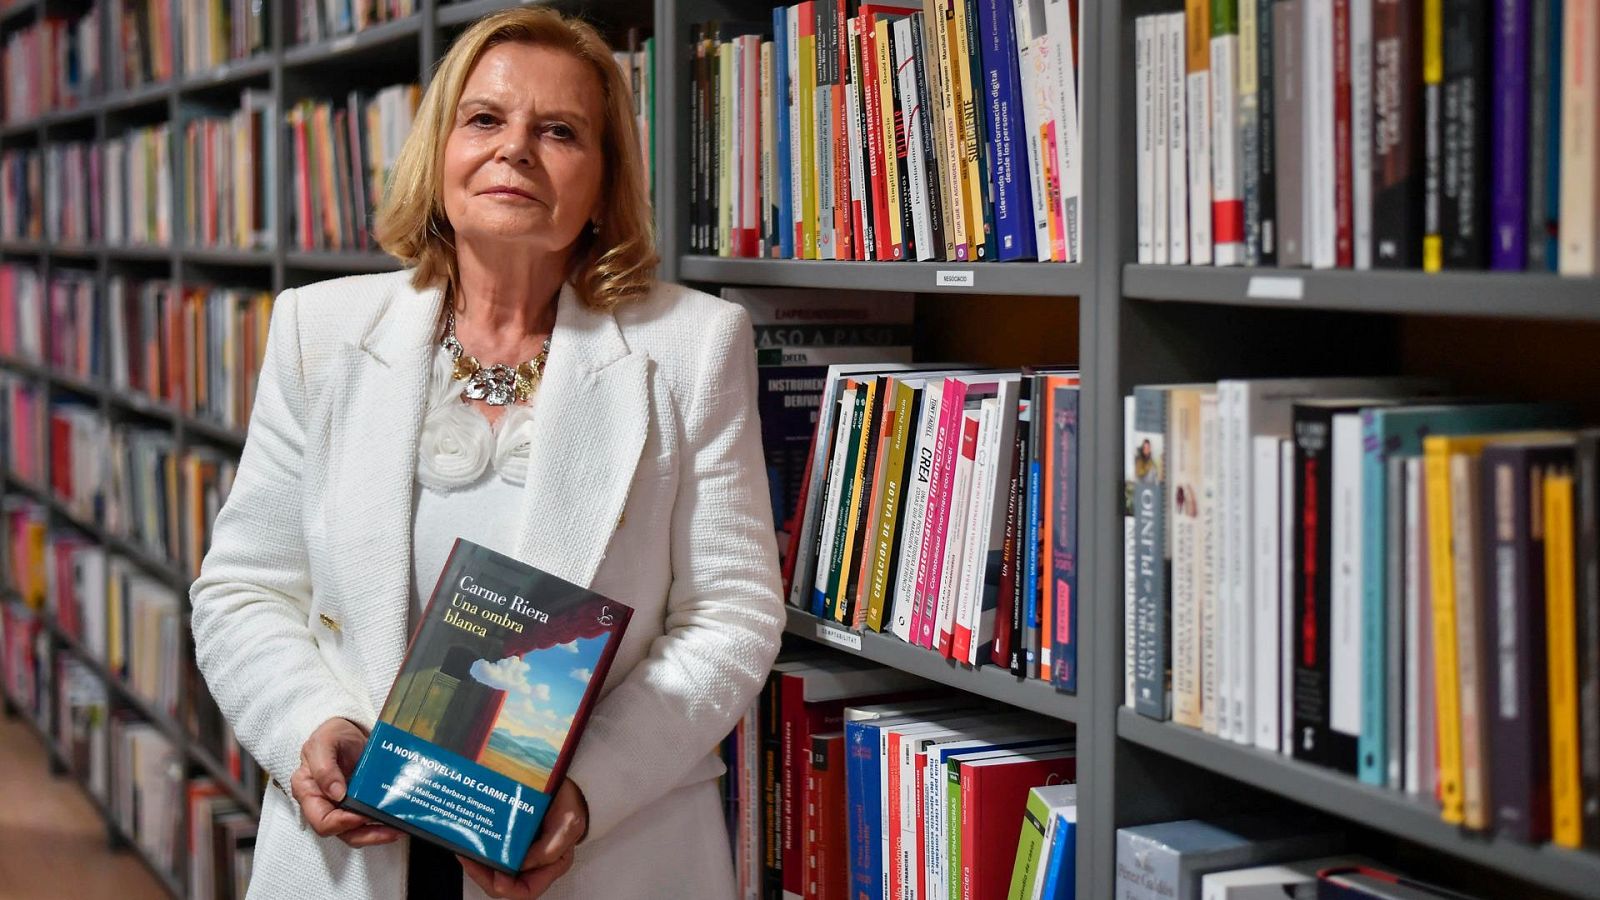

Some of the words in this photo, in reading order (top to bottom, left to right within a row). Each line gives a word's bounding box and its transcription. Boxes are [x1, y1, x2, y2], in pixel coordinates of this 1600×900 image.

[990, 69, 999, 97] digital
[865, 84, 873, 129] HACKING
[1000, 100, 1008, 141] personas
[963, 99, 978, 162] SUFICIENTE
[992, 102, 1003, 163] transformación
[868, 134, 877, 176] GROWTH
[887, 150, 893, 159] tu
[996, 164, 1003, 173] la
[910, 145, 920, 204] Presentaciones
[954, 197, 959, 206] NO
[997, 175, 1006, 219] Liderando
[754, 329, 804, 347] ASO
[814, 330, 826, 346] A
[784, 395, 821, 408] DERIVA
[928, 398, 936, 414] TONY
[925, 414, 934, 437] FADELL
[916, 446, 932, 483] CREA
[884, 480, 896, 518] VALOR
[917, 501, 934, 584] Matemática
[929, 426, 945, 498] financiera
[1008, 477, 1016, 512] OFICINA
[882, 521, 890, 537] DE
[907, 519, 916, 549] MARQUEN
[1006, 525, 1012, 537] EN
[1007, 513, 1013, 523] LA
[1141, 488, 1153, 576] PLINIO
[906, 549, 911, 558] LA
[910, 536, 919, 567] ORTODOXA
[929, 536, 941, 589] Contabilidad
[873, 540, 887, 598] CREACIÓN
[901, 558, 910, 592] DIFERENCIA
[1002, 563, 1008, 576] UN
[450, 592, 480, 615] Una
[480, 604, 526, 633] ombra
[458, 573, 509, 606] Carme
[509, 594, 551, 623] Riera
[443, 608, 490, 637] blanca
[1138, 596, 1147, 680] HISTORIA
[1146, 599, 1155, 681] NATURAL
[380, 740, 394, 751] LA
[393, 745, 420, 763] NOVA
[419, 756, 463, 782] NOVEL·LA
[462, 776, 476, 788] DE
[475, 782, 509, 802] CARME
[414, 786, 443, 804] Mallorca
[445, 800, 456, 810] els
[455, 804, 476, 818] Estats
[474, 813, 495, 827] Units,
[431, 781, 441, 790] de
[440, 785, 467, 801] Barbara
[466, 796, 497, 814] Simpson.
[767, 792, 773, 803] de
[411, 795, 430, 808] passa
[429, 804, 458, 821] comptes
[457, 816, 474, 828] amb
[472, 823, 481, 831] el
[480, 826, 504, 841] passat.
[775, 860, 781, 869] Un
[894, 836, 902, 884] económico
[1024, 863, 1030, 873] de
[1026, 840, 1035, 862] casos
